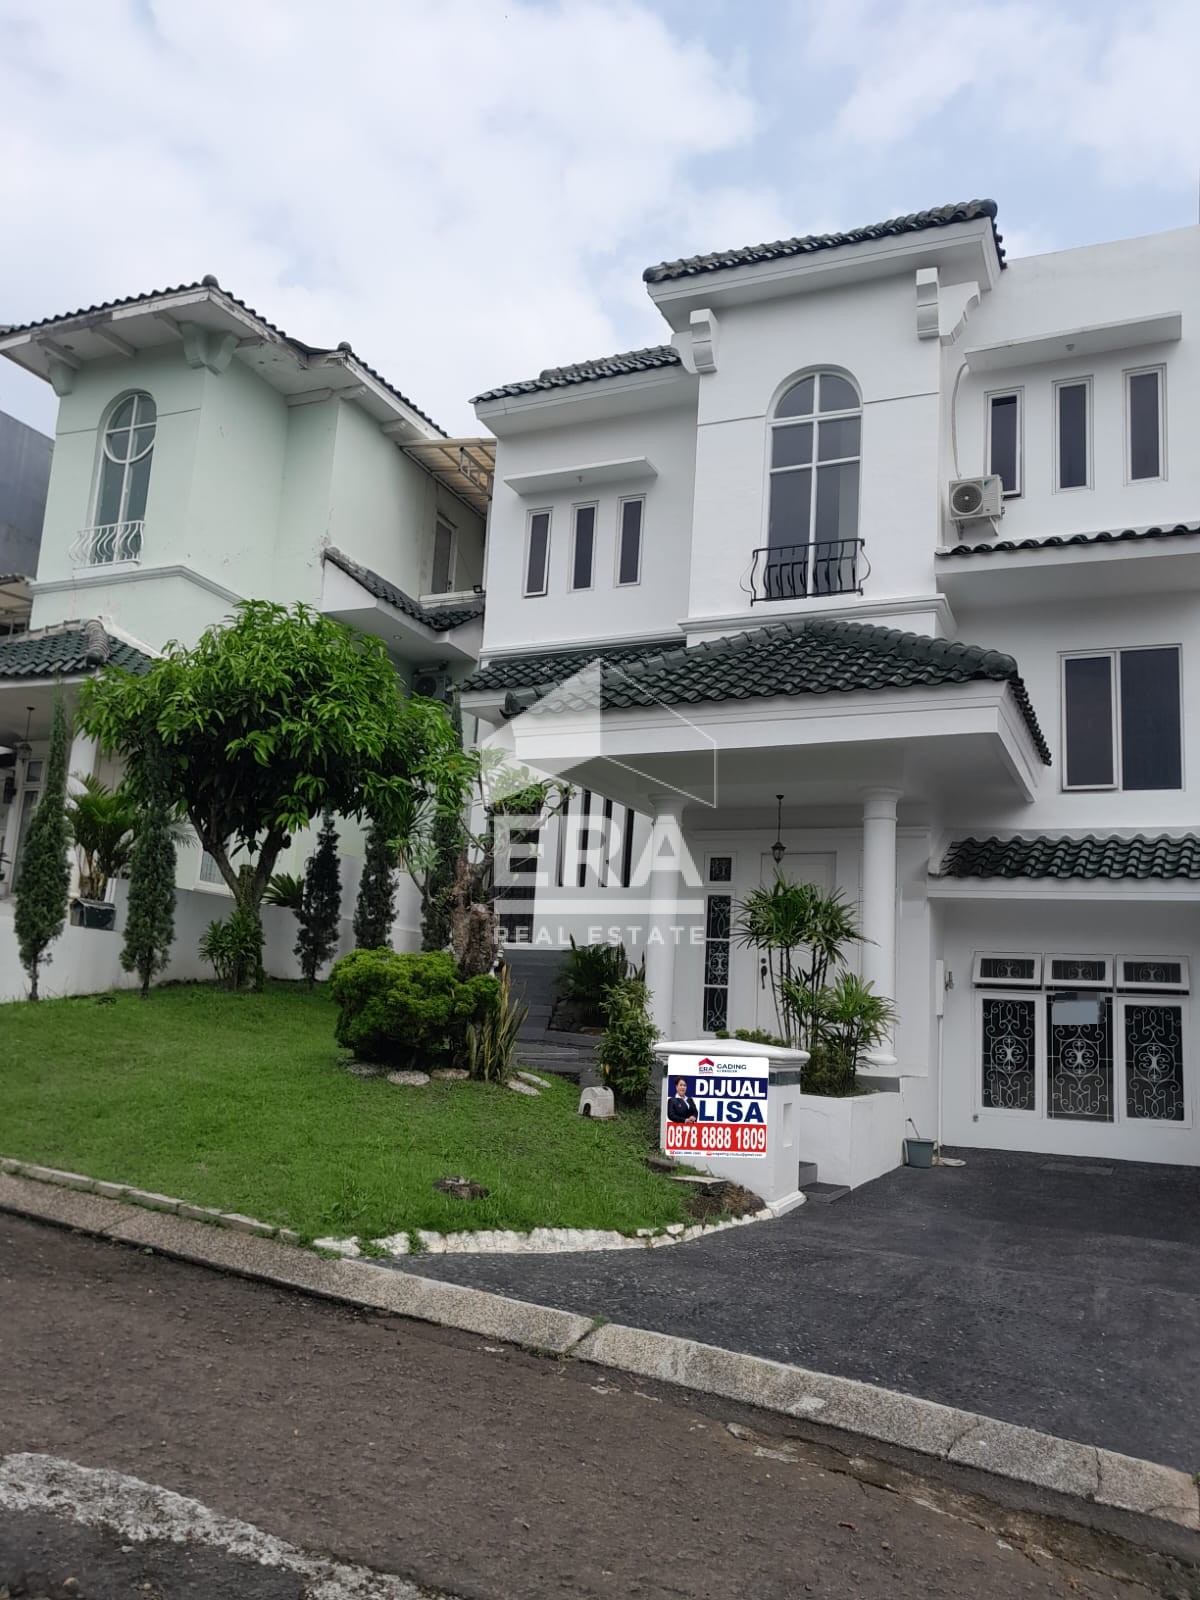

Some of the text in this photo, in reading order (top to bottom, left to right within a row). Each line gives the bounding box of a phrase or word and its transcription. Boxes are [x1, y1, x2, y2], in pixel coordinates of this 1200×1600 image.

[695, 1079, 766, 1098] DIJUAL
[698, 1100, 765, 1123] LISA
[667, 1125, 766, 1150] 0878 8888 1809
